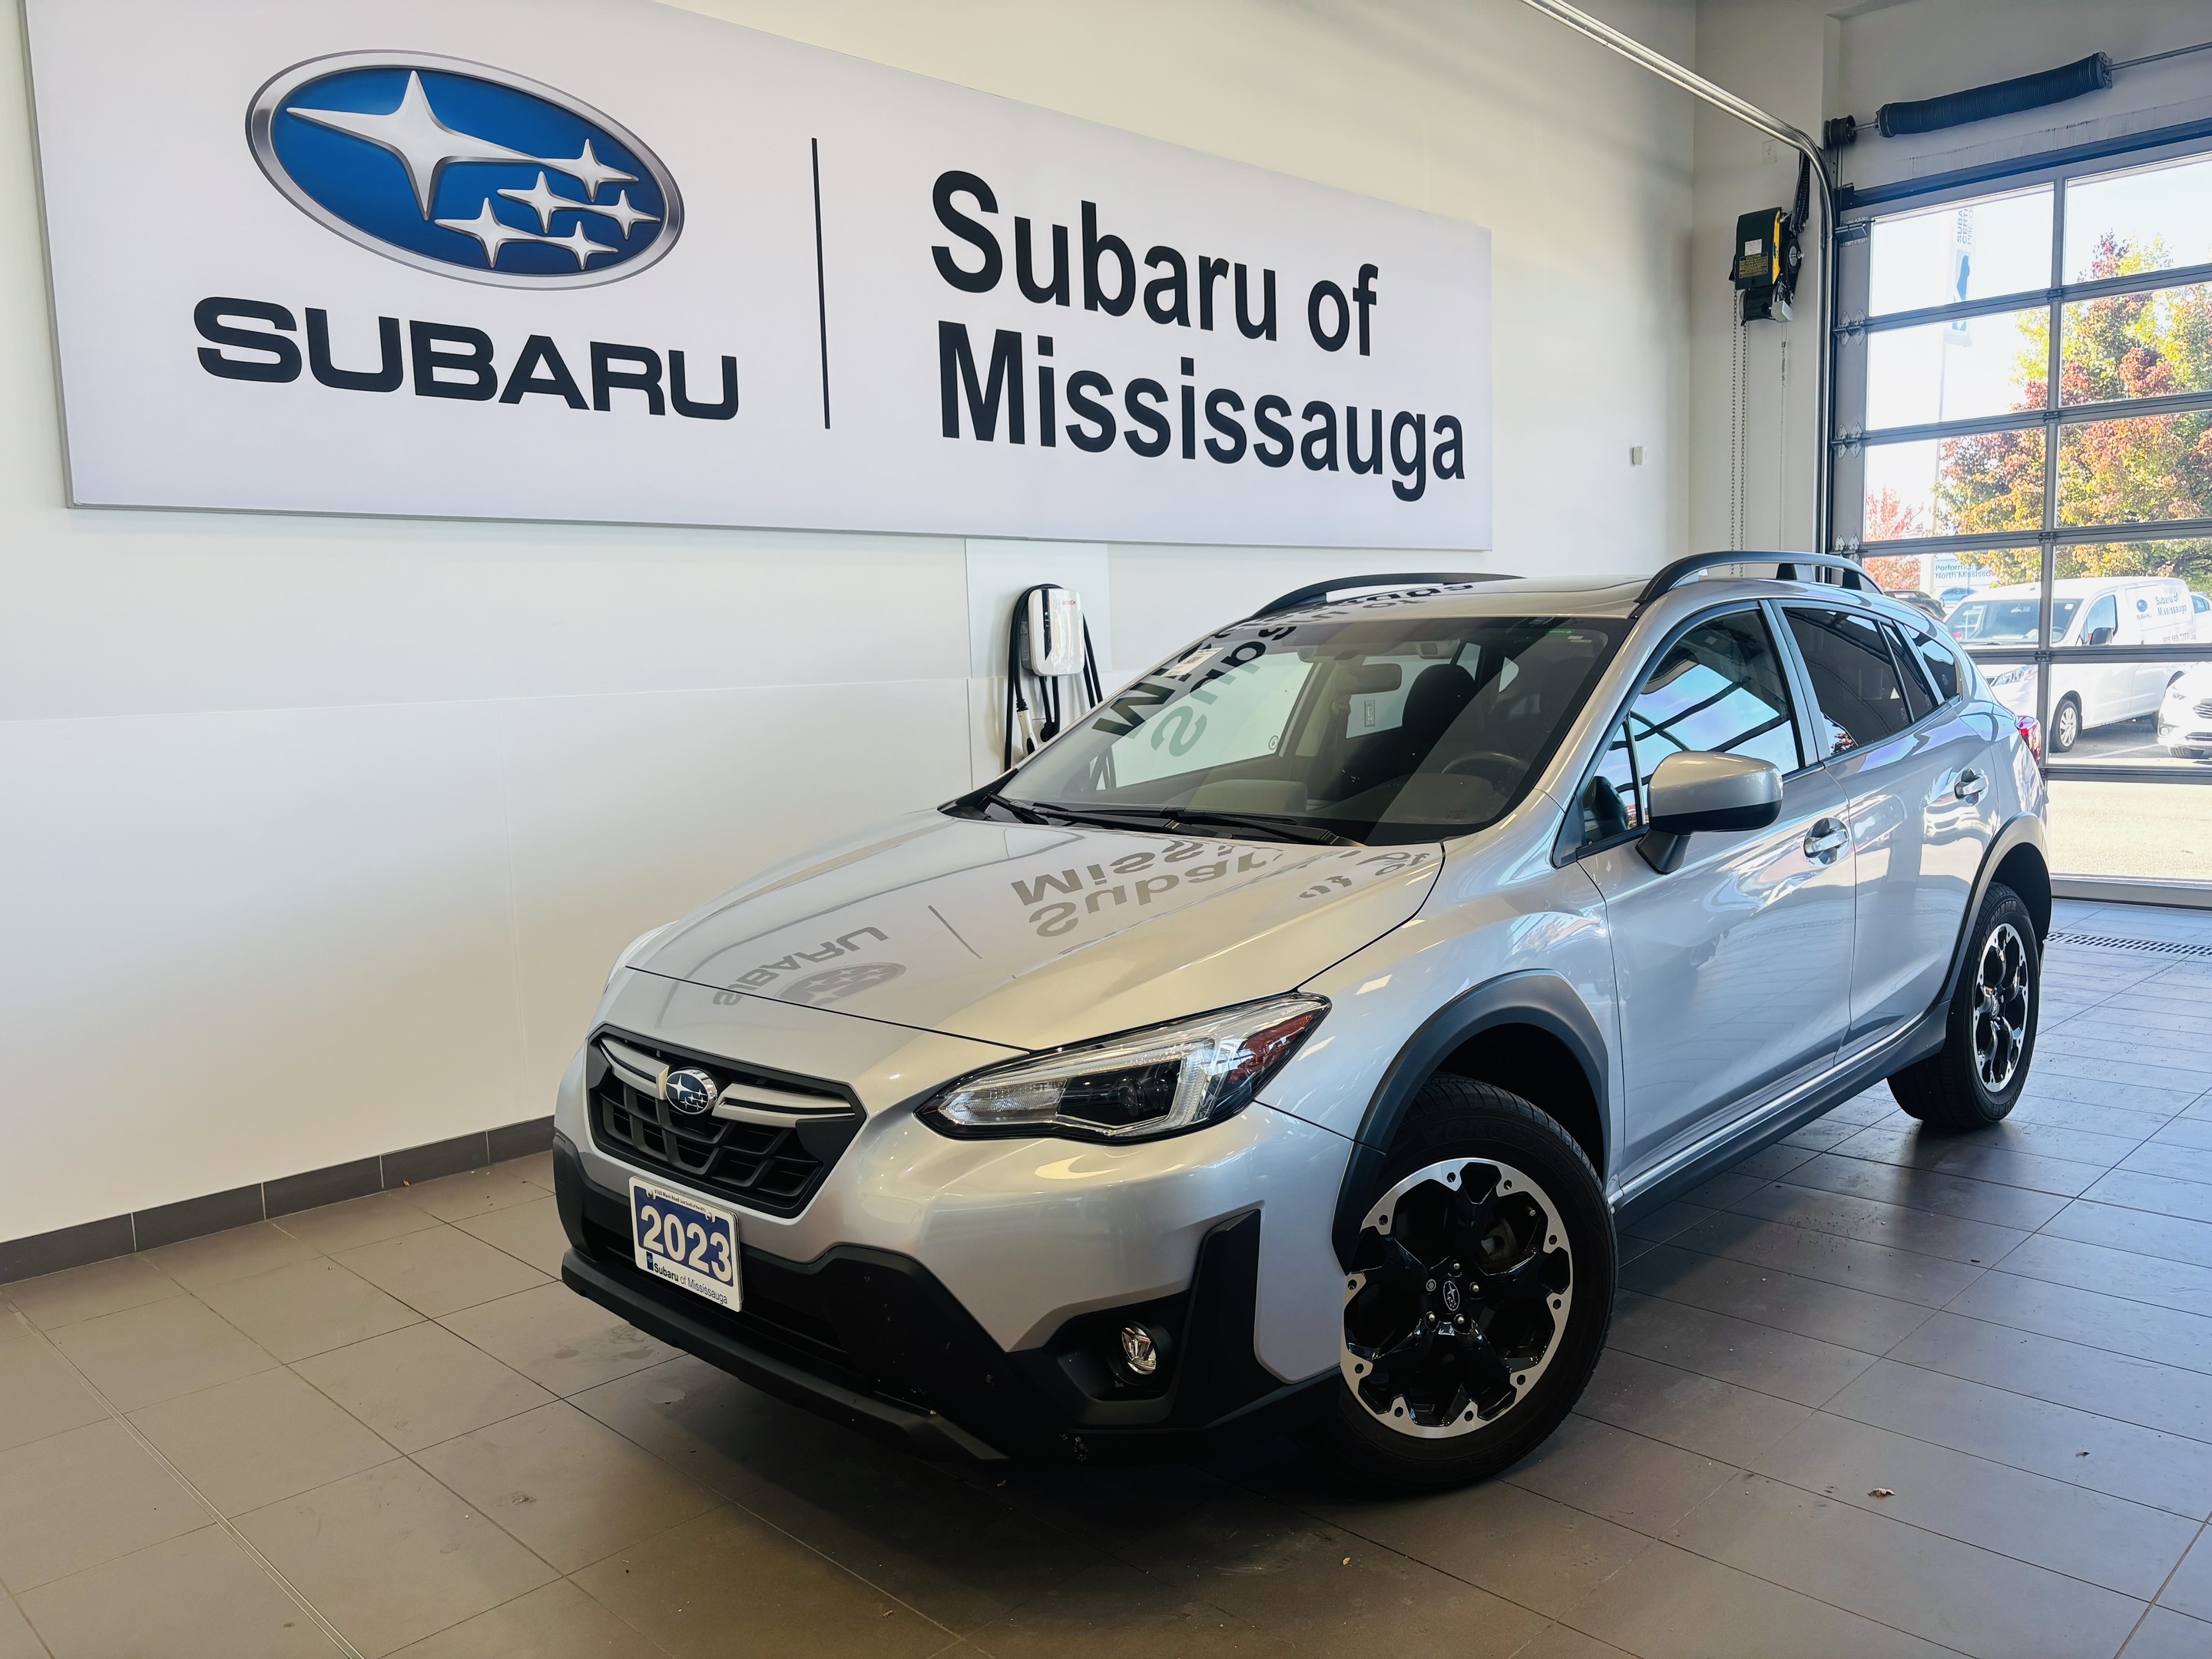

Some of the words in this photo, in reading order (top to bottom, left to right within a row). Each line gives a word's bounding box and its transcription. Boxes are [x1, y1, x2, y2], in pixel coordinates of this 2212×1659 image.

[931, 169, 1277, 341] Subaru
[1307, 263, 1379, 356] of
[193, 296, 739, 420] SUBARU
[938, 320, 1465, 502] Mississauga
[641, 1204, 733, 1283] 2023
[654, 1263, 679, 1283] Subaru
[680, 1275, 687, 1285] of
[687, 1277, 728, 1304] Mississauga
